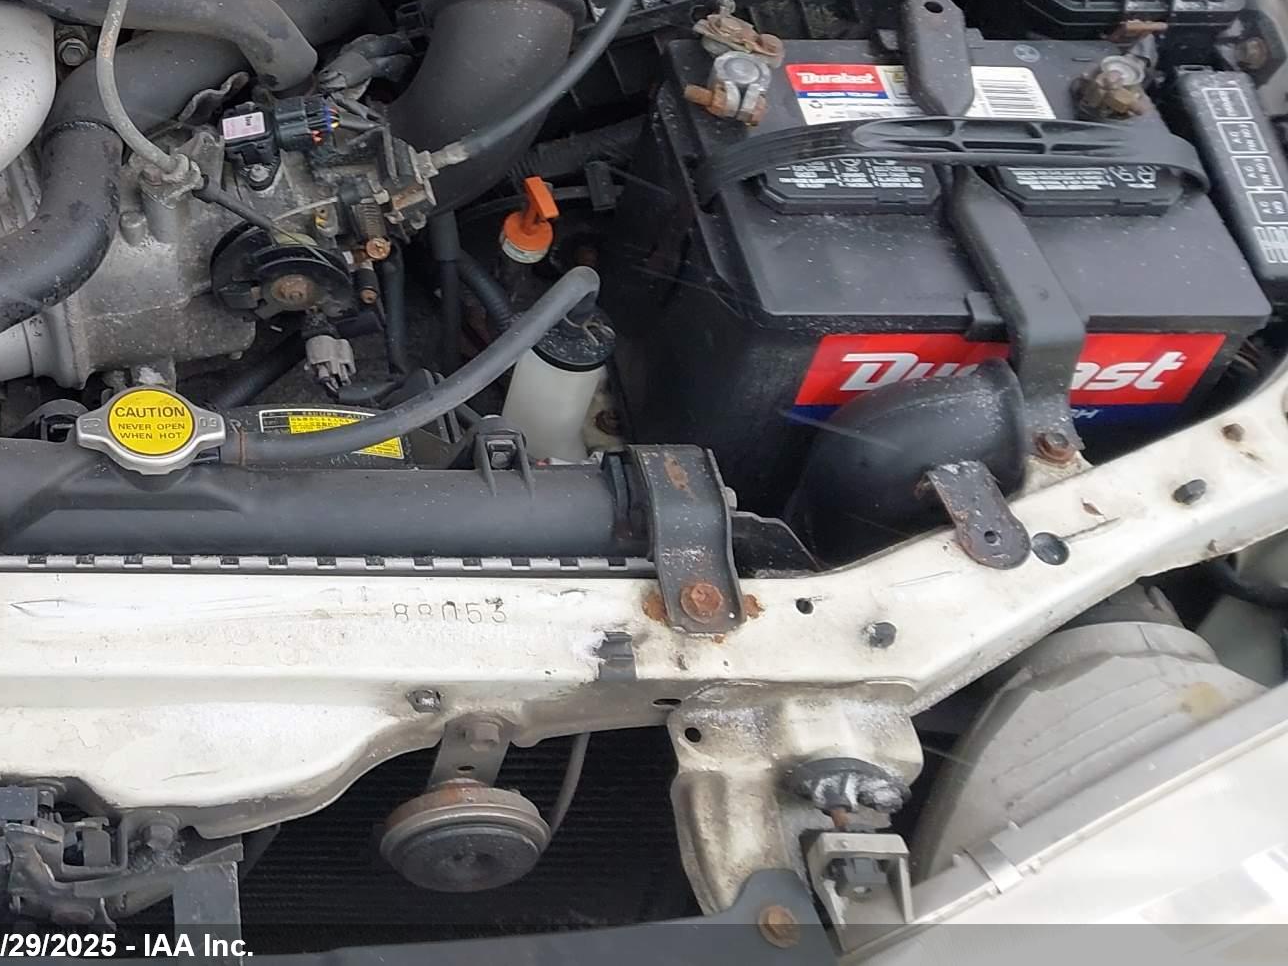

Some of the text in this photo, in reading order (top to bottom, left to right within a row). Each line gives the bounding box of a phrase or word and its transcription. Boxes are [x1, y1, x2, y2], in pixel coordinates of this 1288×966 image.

[796, 71, 877, 84] Duralast
[114, 406, 186, 418] CAUTION
[118, 422, 185, 431] NEVER OPEN
[119, 432, 153, 440] WHEN
